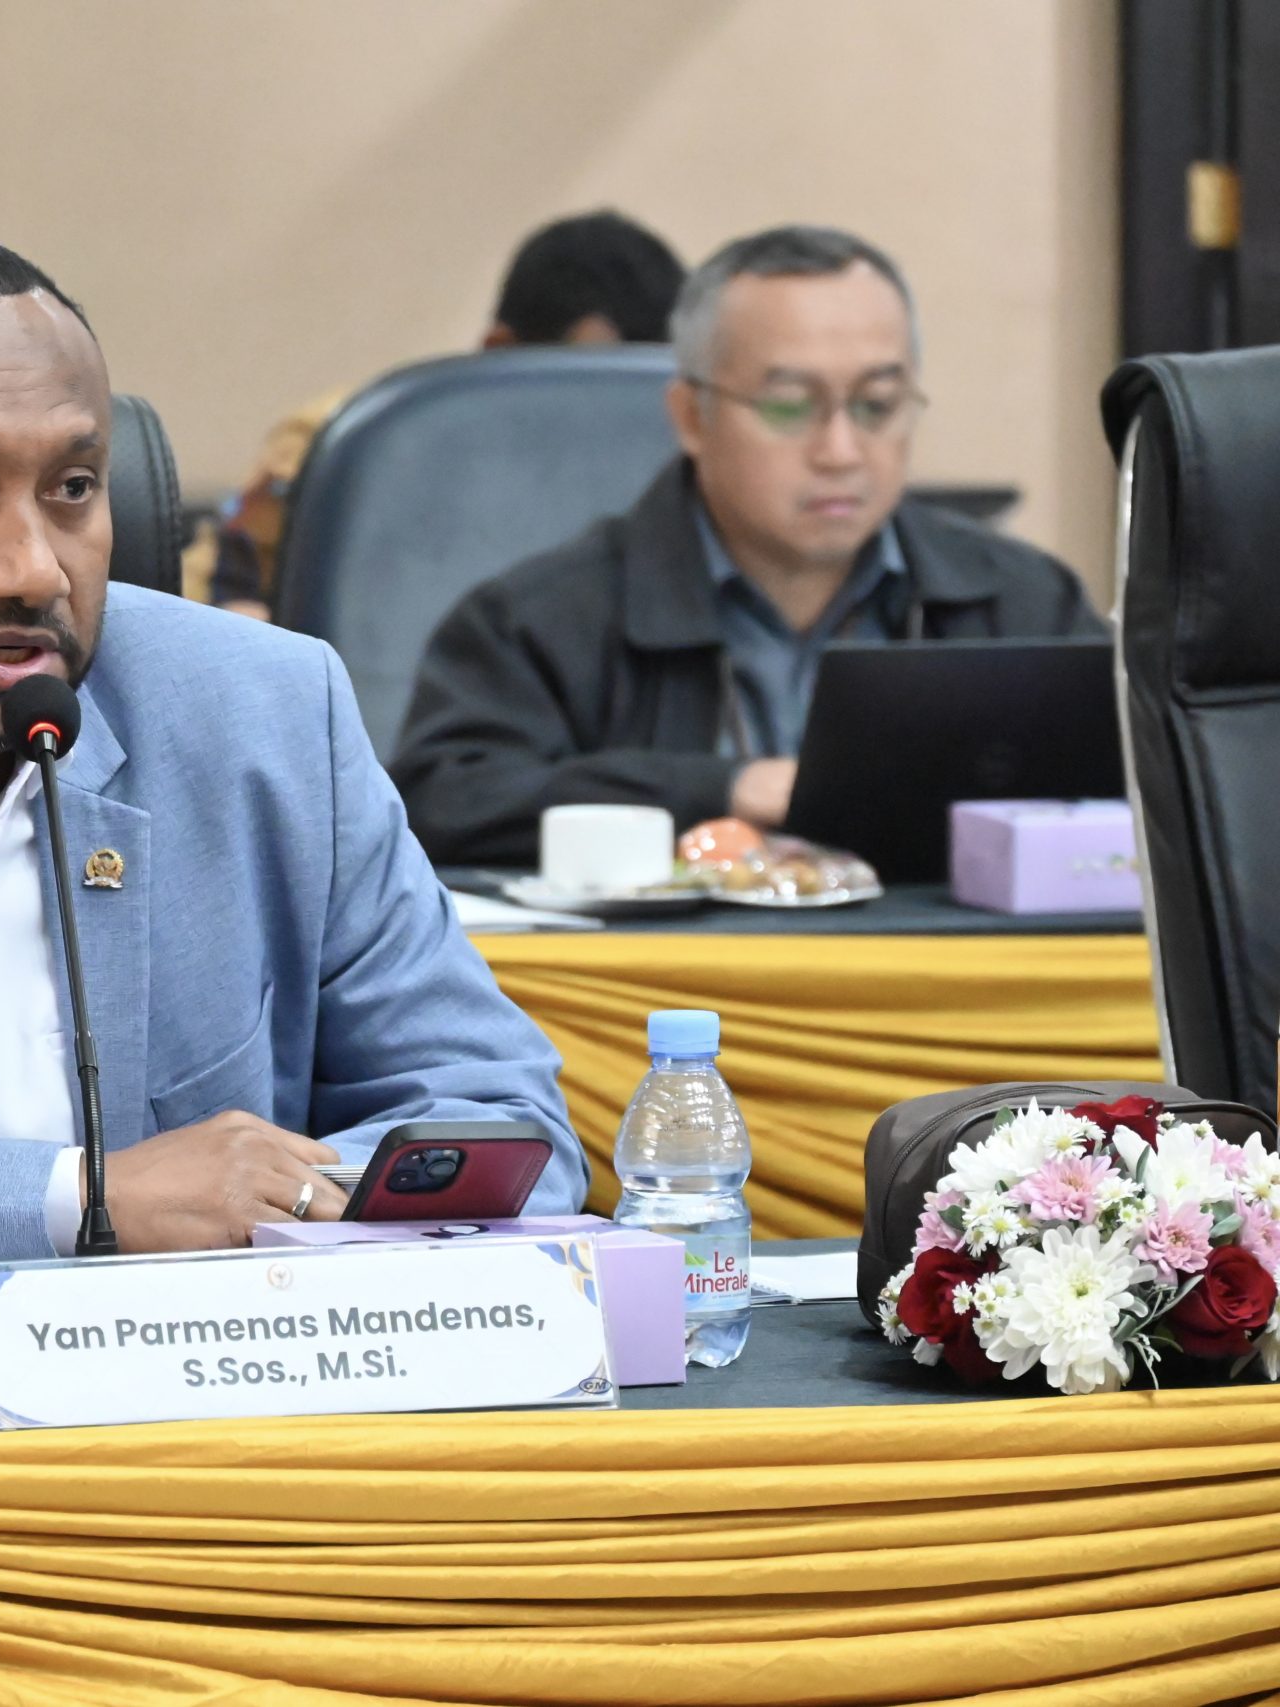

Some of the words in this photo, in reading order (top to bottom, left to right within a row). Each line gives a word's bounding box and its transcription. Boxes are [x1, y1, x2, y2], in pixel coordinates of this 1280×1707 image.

[714, 1251, 735, 1273] Le
[27, 1323, 106, 1351] Yan
[115, 1314, 318, 1347] Parmenas
[327, 1302, 545, 1336] Mandenas,
[182, 1357, 308, 1388] S.Sos.,
[316, 1345, 407, 1381] M.Si.
[583, 1381, 607, 1390] GM
